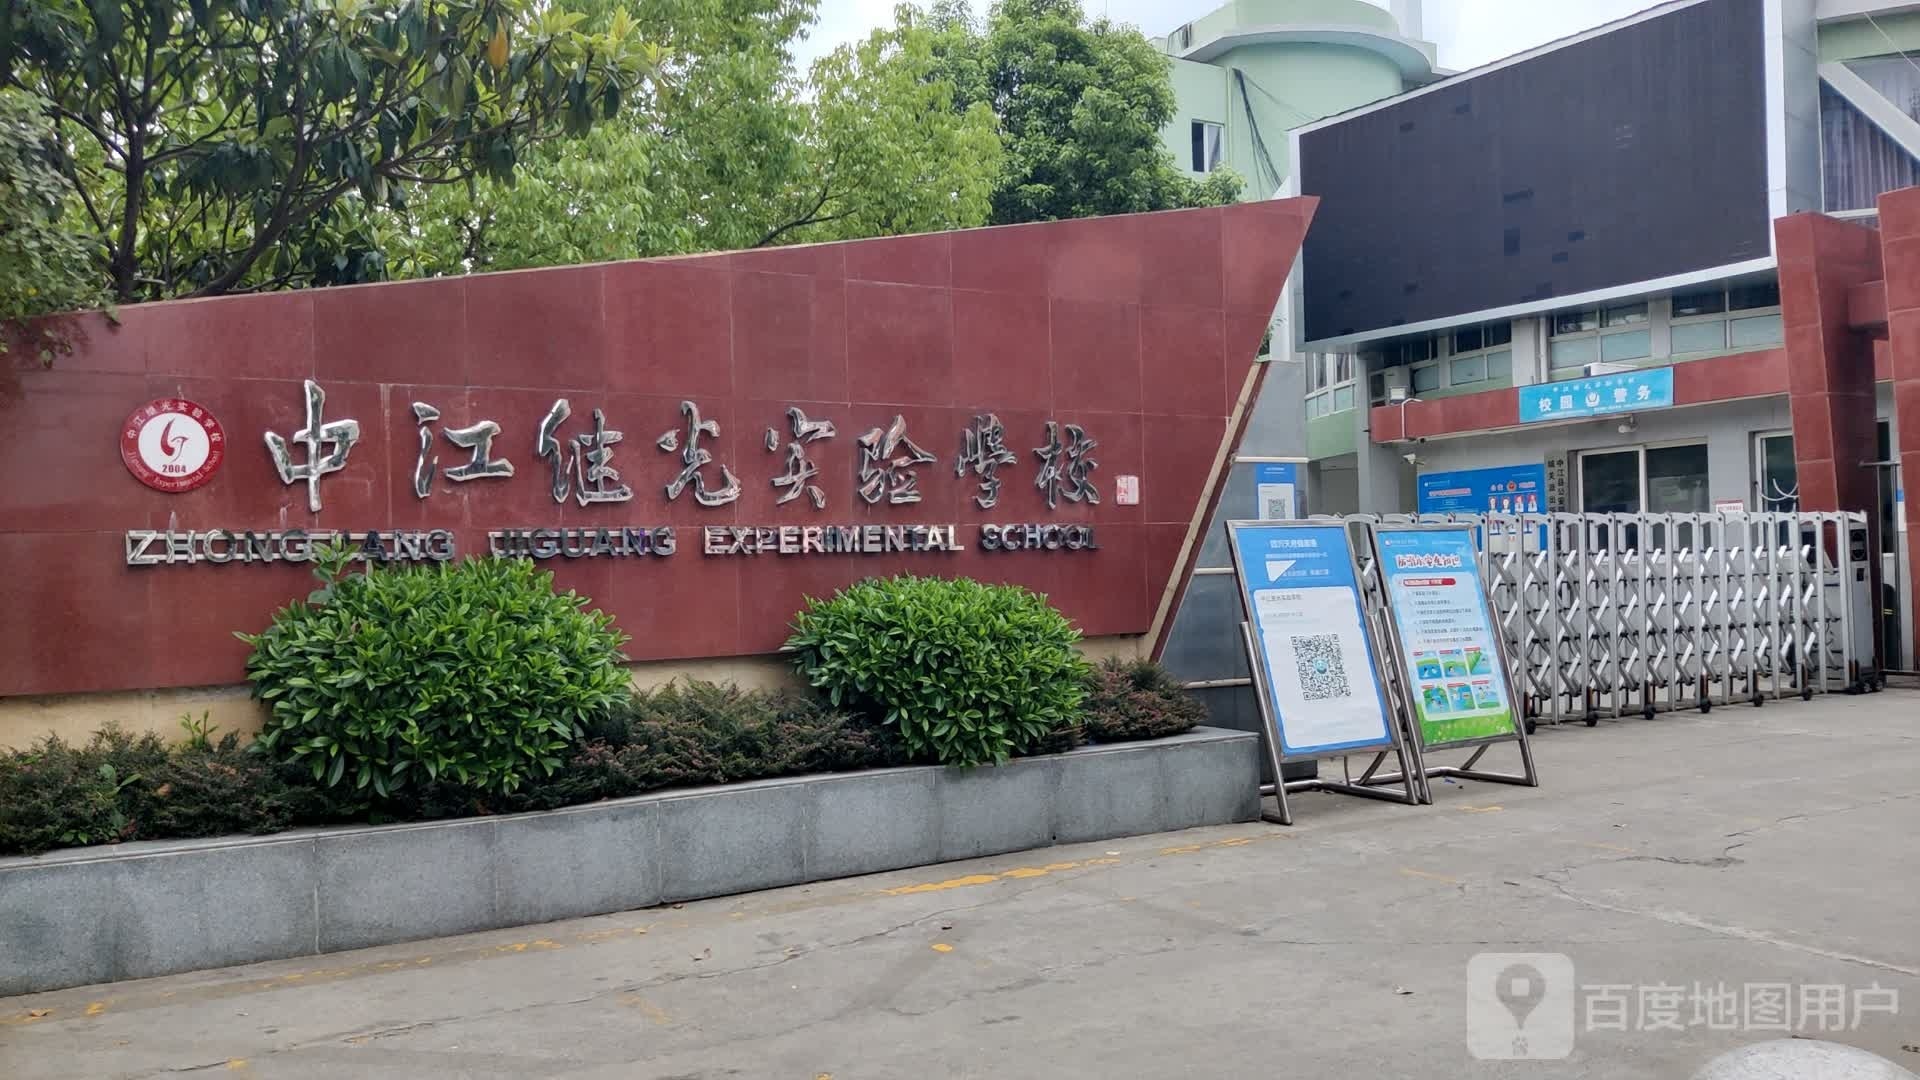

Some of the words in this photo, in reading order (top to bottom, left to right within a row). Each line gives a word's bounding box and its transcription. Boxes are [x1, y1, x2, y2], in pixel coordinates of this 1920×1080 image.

[162, 464, 187, 473] 2004
[704, 525, 965, 554] EXPERIMENTAL
[980, 523, 1096, 550] SCHOOL
